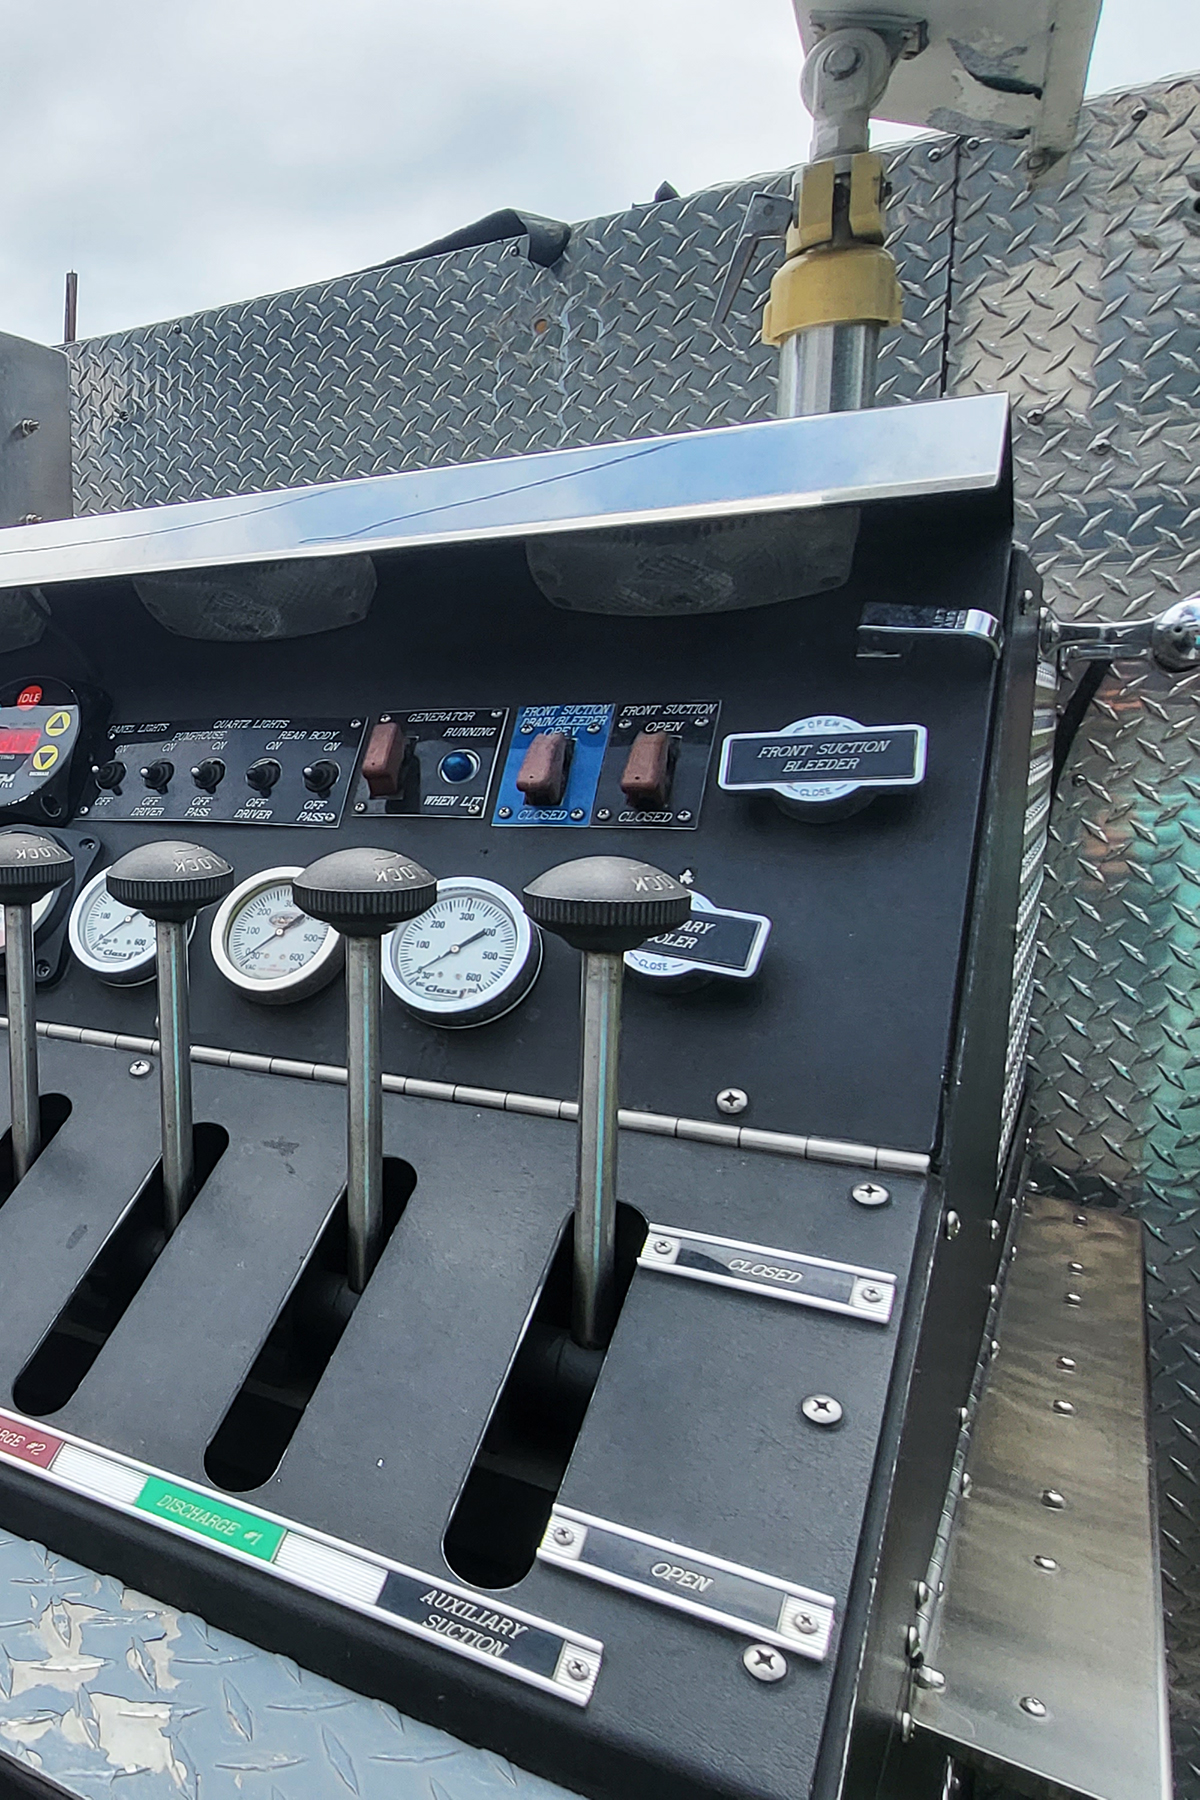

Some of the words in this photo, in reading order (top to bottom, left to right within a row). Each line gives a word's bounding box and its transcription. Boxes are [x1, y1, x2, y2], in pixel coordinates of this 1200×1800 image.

[19, 692, 41, 704] IDLE
[522, 706, 560, 717] FRONT
[562, 704, 611, 716] SUCTION
[620, 705, 659, 717] FRONT
[662, 703, 719, 716] SUCTION
[407, 711, 476, 723] GENERATOR
[137, 723, 171, 733] LIGHTS
[213, 719, 252, 729] QUARTZ
[253, 719, 291, 729] LIGHTS
[645, 721, 685, 733] OPEN
[807, 719, 841, 730] OPEN
[278, 731, 307, 741] REAR
[308, 731, 341, 741] BODY
[442, 727, 497, 738] RUNNING
[161, 743, 177, 752] ON
[211, 741, 228, 751] ON
[265, 742, 283, 751] ON
[323, 742, 342, 752] ON
[756, 745, 814, 758] FRONT
[816, 740, 891, 756] SUCTION
[781, 757, 861, 773] BLEEDER
[799, 786, 833, 797] CLOSE
[94, 797, 114, 806] OFF
[141, 796, 163, 806] OFF
[191, 797, 214, 806] OFF
[245, 798, 269, 808] OFF
[303, 800, 328, 811] OFF
[424, 795, 456, 806] WHEN
[131, 807, 165, 817] DRIVER
[184, 808, 211, 817] PASS
[234, 809, 273, 820] DRIVER
[296, 811, 326, 822] PASS
[517, 809, 568, 821] CLOSED
[618, 811, 674, 823] CLOSED
[100, 912, 112, 920] 100
[256, 908, 272, 916] 200
[459, 912, 475, 922] 300
[429, 920, 446, 929] 200
[245, 926, 261, 935] 100
[133, 938, 147, 947] 600
[303, 934, 318, 943] 500
[416, 940, 430, 949] 100
[288, 953, 305, 962] 600
[481, 951, 498, 960] 500
[638, 959, 669, 972] CLOSE
[465, 972, 482, 982] 600
[726, 1258, 804, 1285] CLOSED
[26, 1440, 47, 1457] #2
[155, 1492, 242, 1538] DISCHARGE
[243, 1530, 265, 1547] #1
[649, 1562, 715, 1593] OPEN
[419, 1588, 530, 1641] AUXILIARY
[420, 1612, 510, 1658] SUCTION
